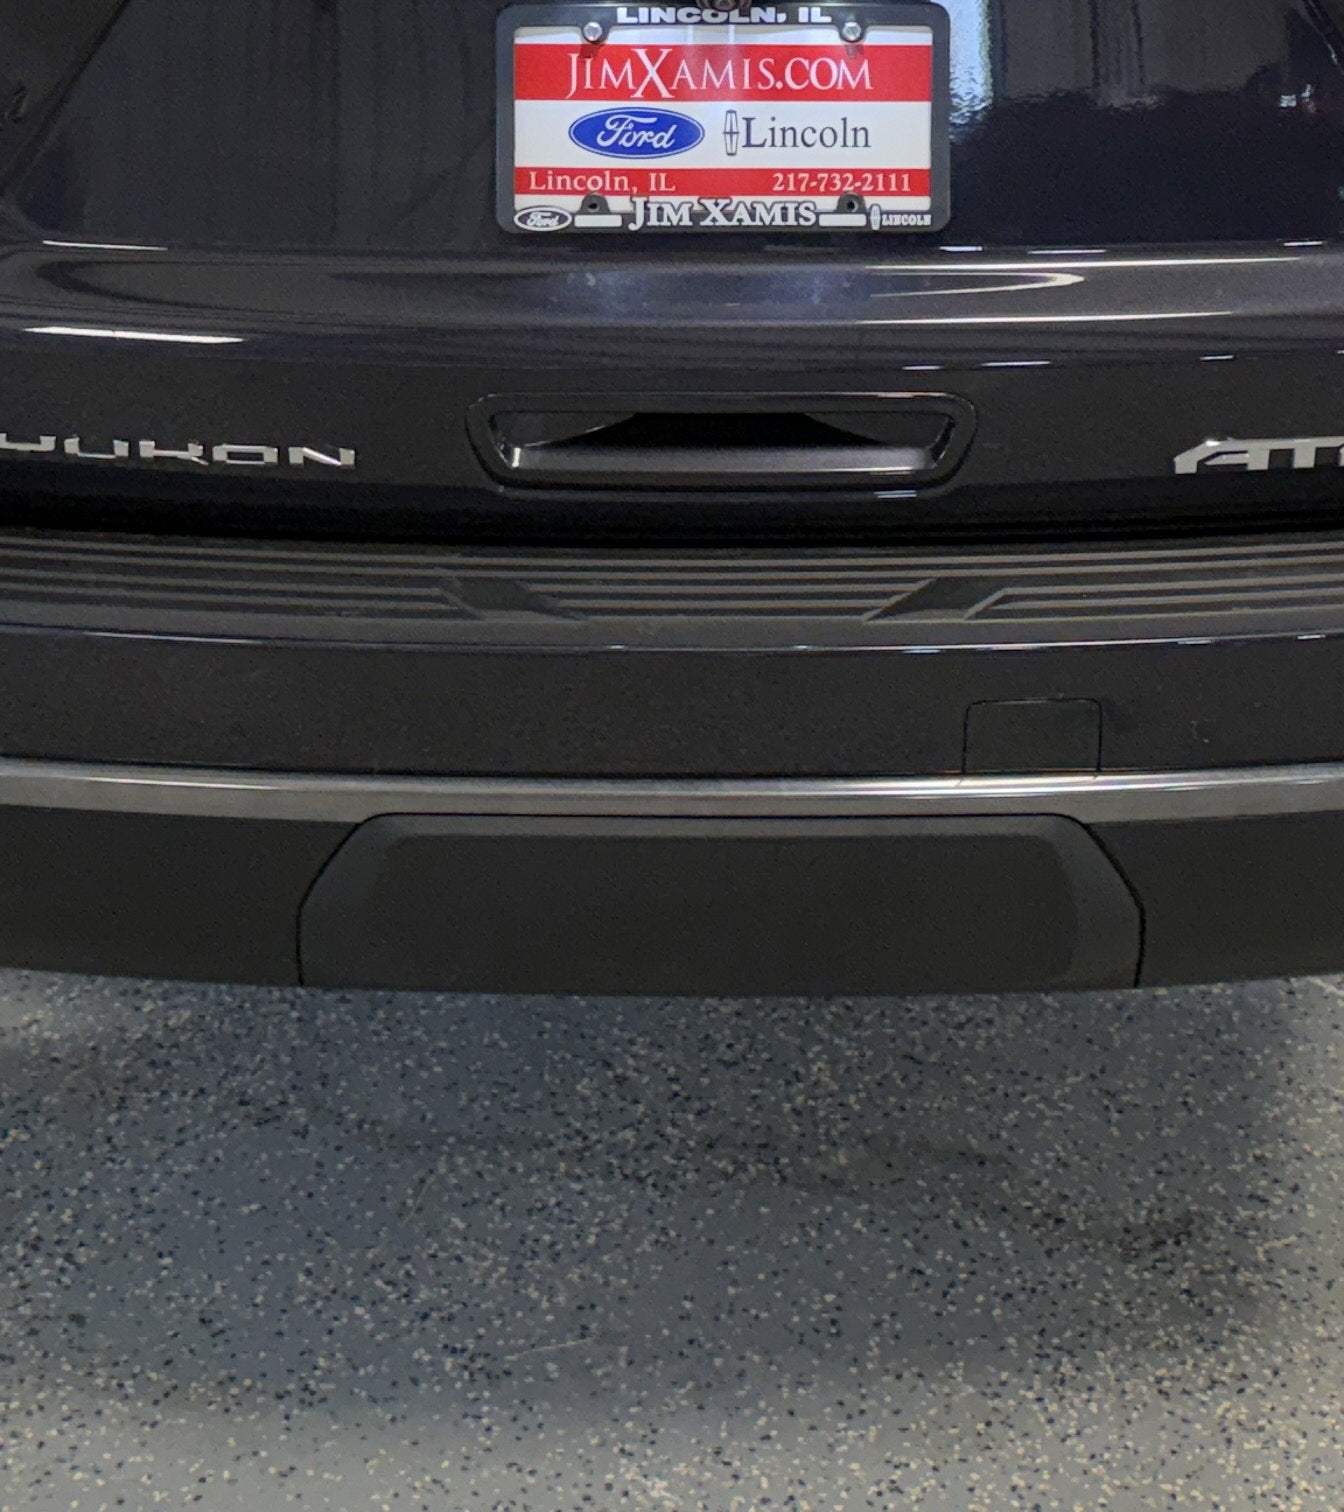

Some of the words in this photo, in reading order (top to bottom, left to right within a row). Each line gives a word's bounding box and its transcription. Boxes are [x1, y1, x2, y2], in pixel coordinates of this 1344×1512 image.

[616, 7, 787, 24] LINCOLN,
[798, 7, 832, 24] IL
[565, 48, 874, 99] JIMXAMIS.COM
[595, 114, 676, 150] Ford
[741, 116, 872, 150] Lincoln
[529, 170, 639, 194] Lincoln,
[649, 173, 676, 192] IL
[772, 172, 911, 192] 217-732-2111
[525, 212, 559, 228] Ford
[628, 196, 692, 231] JIM
[700, 196, 817, 227] XAMIS
[881, 213, 932, 226] LINCOLN
